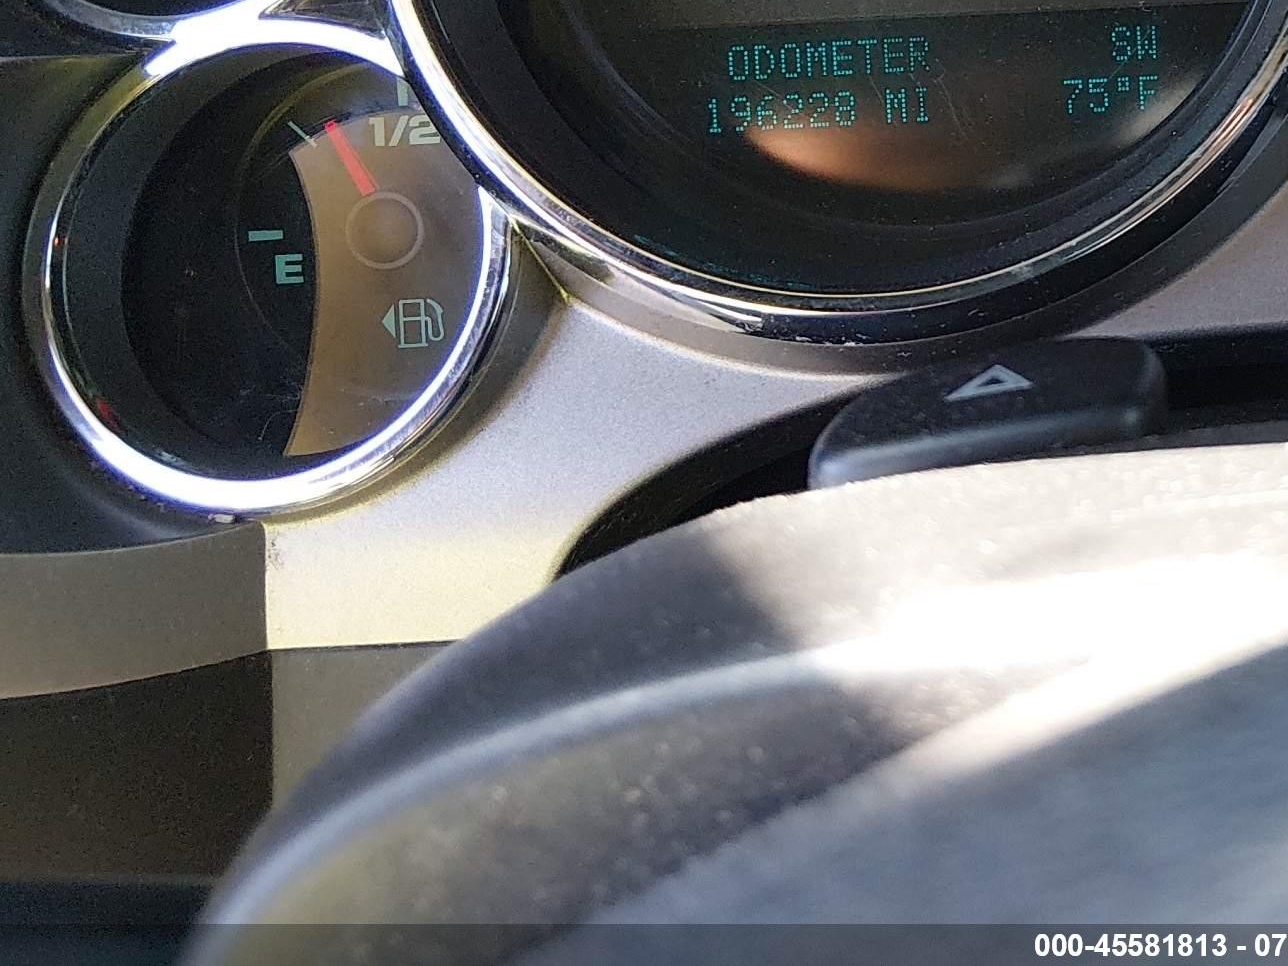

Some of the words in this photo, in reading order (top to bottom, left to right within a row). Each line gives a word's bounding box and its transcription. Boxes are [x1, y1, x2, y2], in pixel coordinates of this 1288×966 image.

[726, 35, 931, 81] ODOMETER
[1112, 25, 1159, 61] SW
[708, 90, 857, 133] 196228
[885, 86, 929, 124] MI
[1063, 74, 1159, 114] 75°F
[368, 113, 441, 147] 1/2
[275, 253, 305, 285] E
